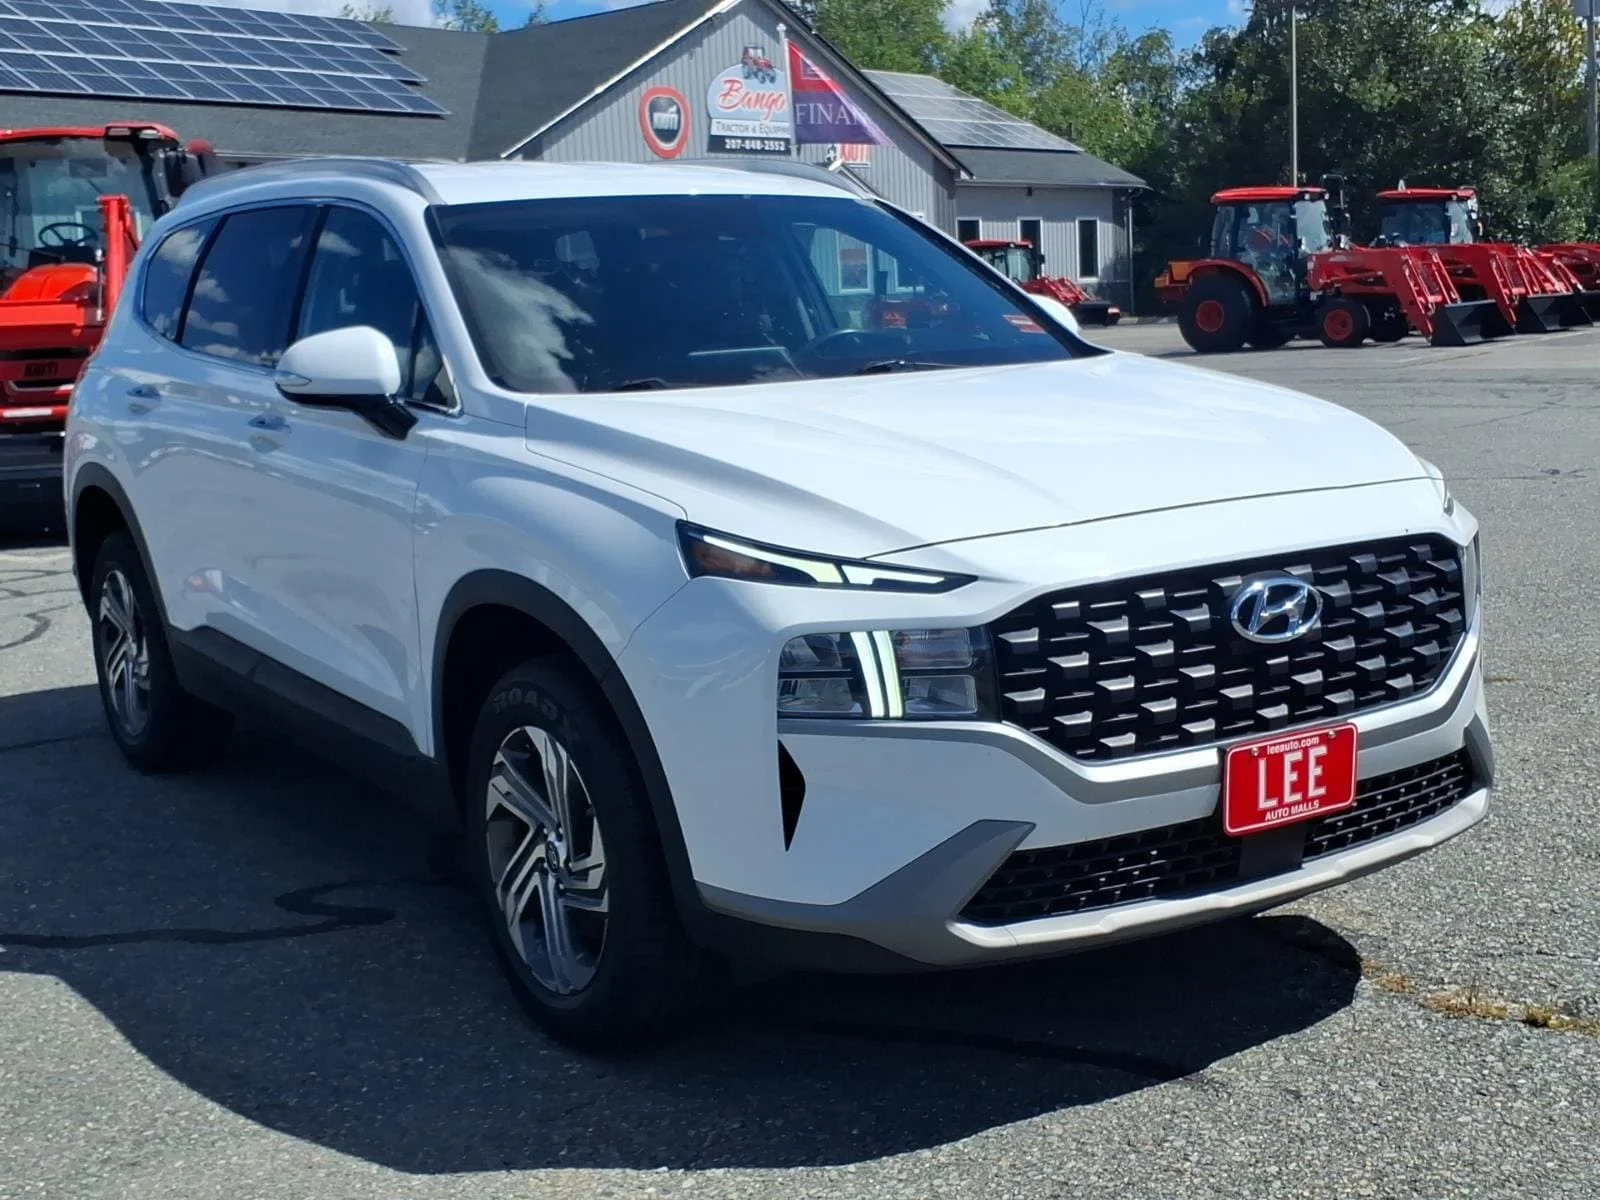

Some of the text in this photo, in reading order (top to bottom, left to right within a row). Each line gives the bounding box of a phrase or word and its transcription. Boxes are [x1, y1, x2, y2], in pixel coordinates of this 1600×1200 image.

[718, 79, 786, 121] Bango
[1266, 736, 1319, 755] leeauto.com
[1258, 744, 1328, 811] LEE
[1264, 800, 1319, 821] AUTO MALLS
